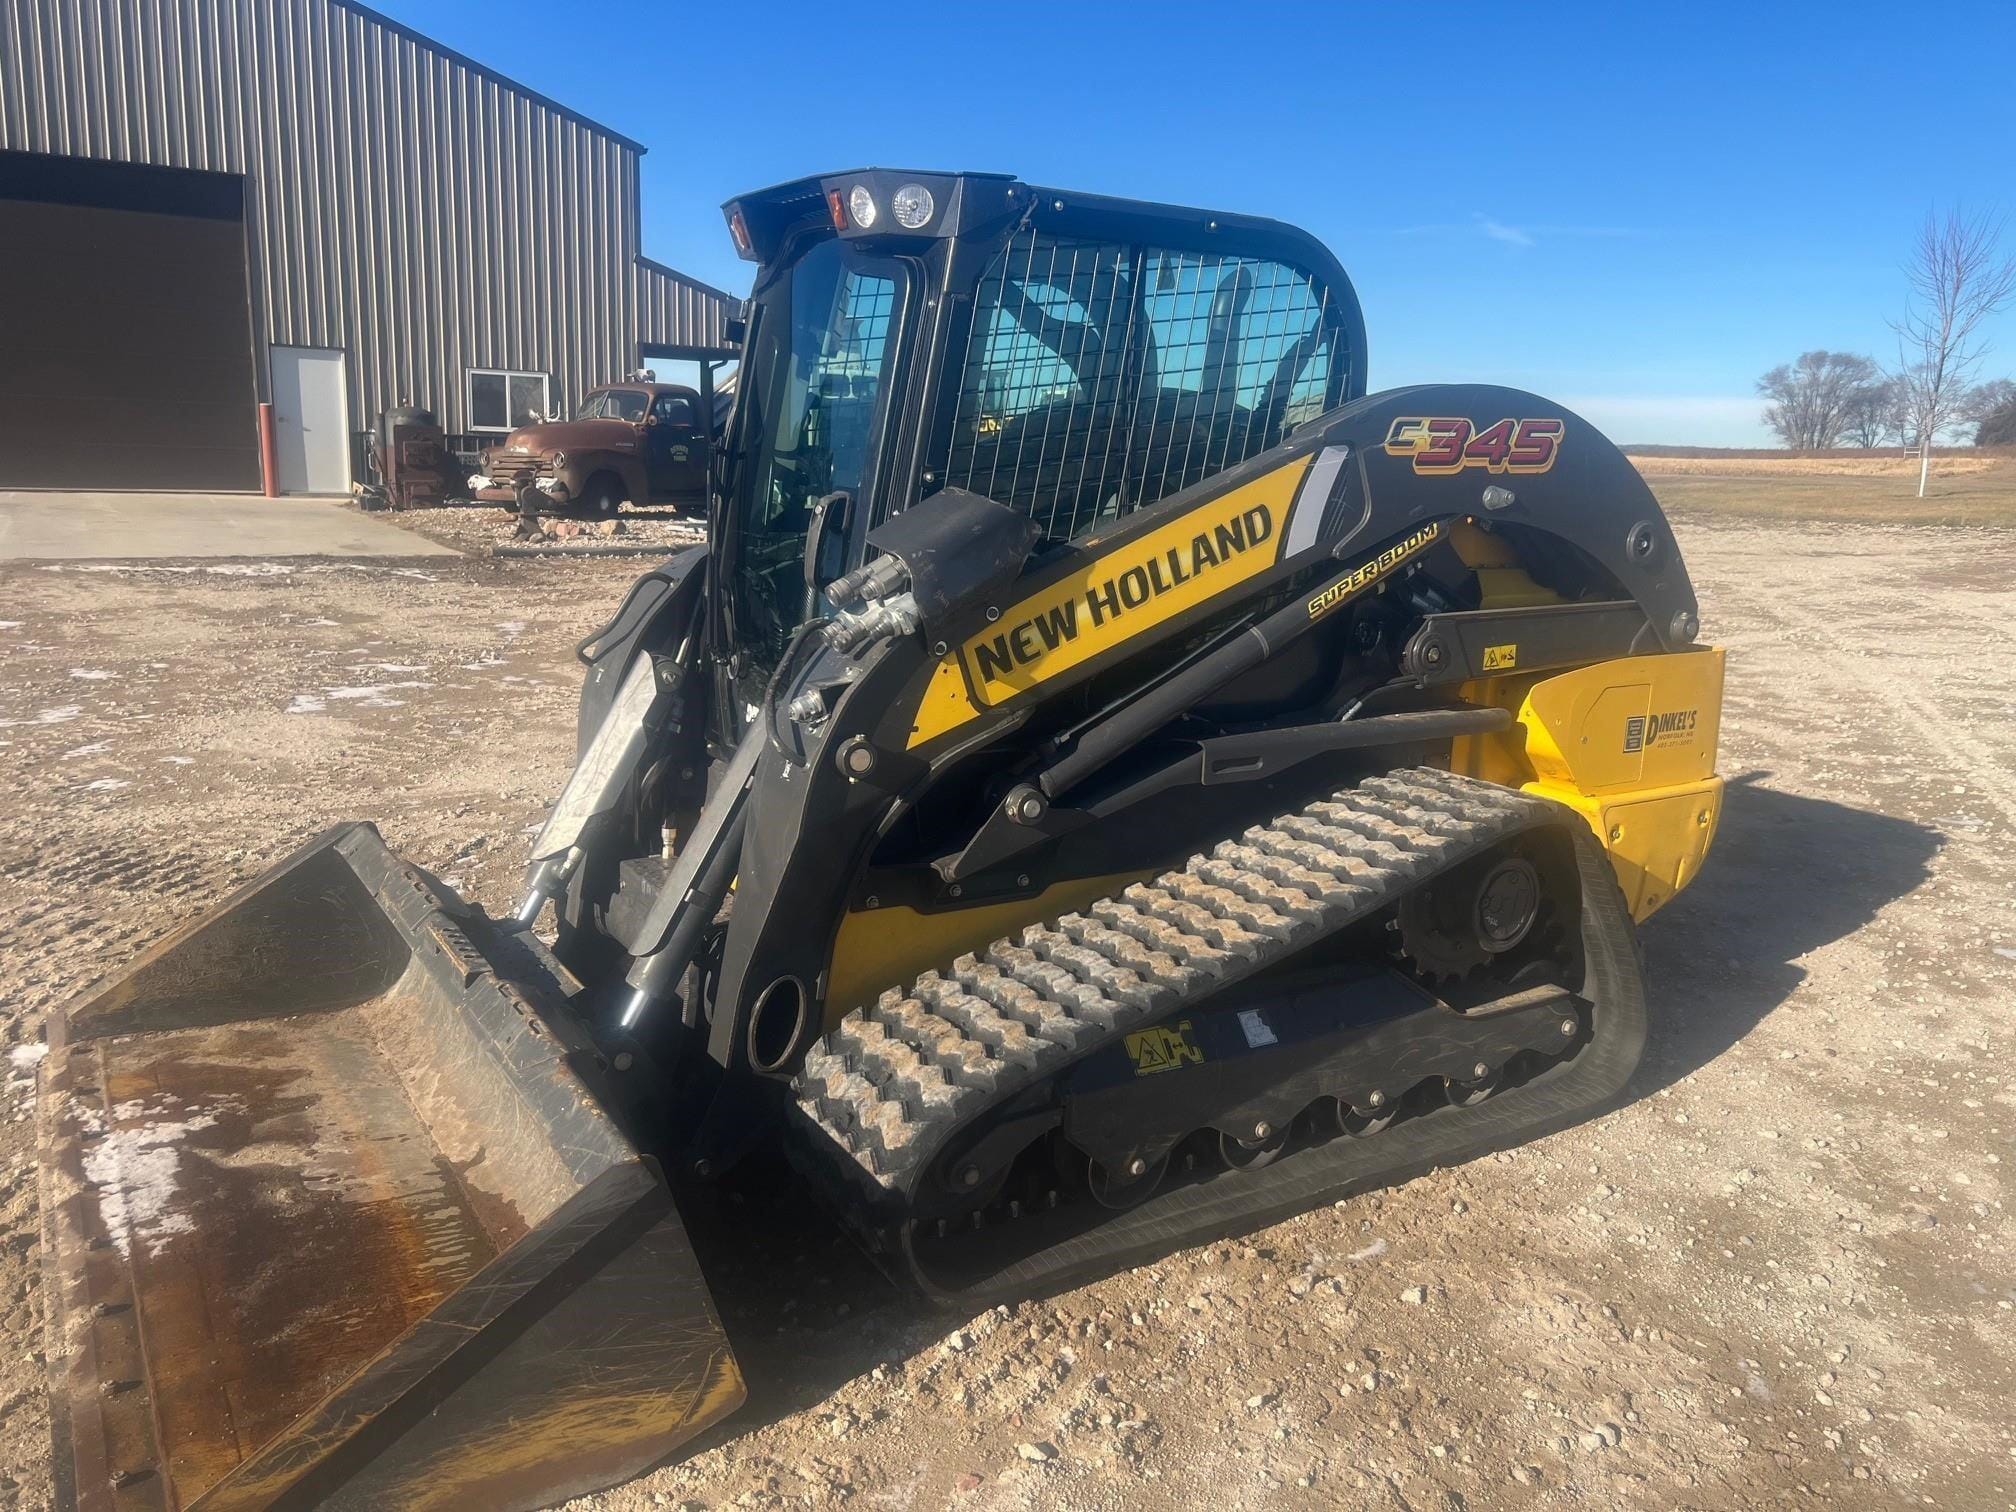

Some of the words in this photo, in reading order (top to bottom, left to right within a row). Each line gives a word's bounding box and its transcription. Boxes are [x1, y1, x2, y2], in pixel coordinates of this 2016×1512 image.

[974, 597, 1080, 685] NEW
[1085, 503, 1273, 628] HOLLAND
[1307, 560, 1378, 620] SUPER
[1378, 521, 1439, 573] BOOM
[1645, 710, 1697, 746] DINKEL'S
